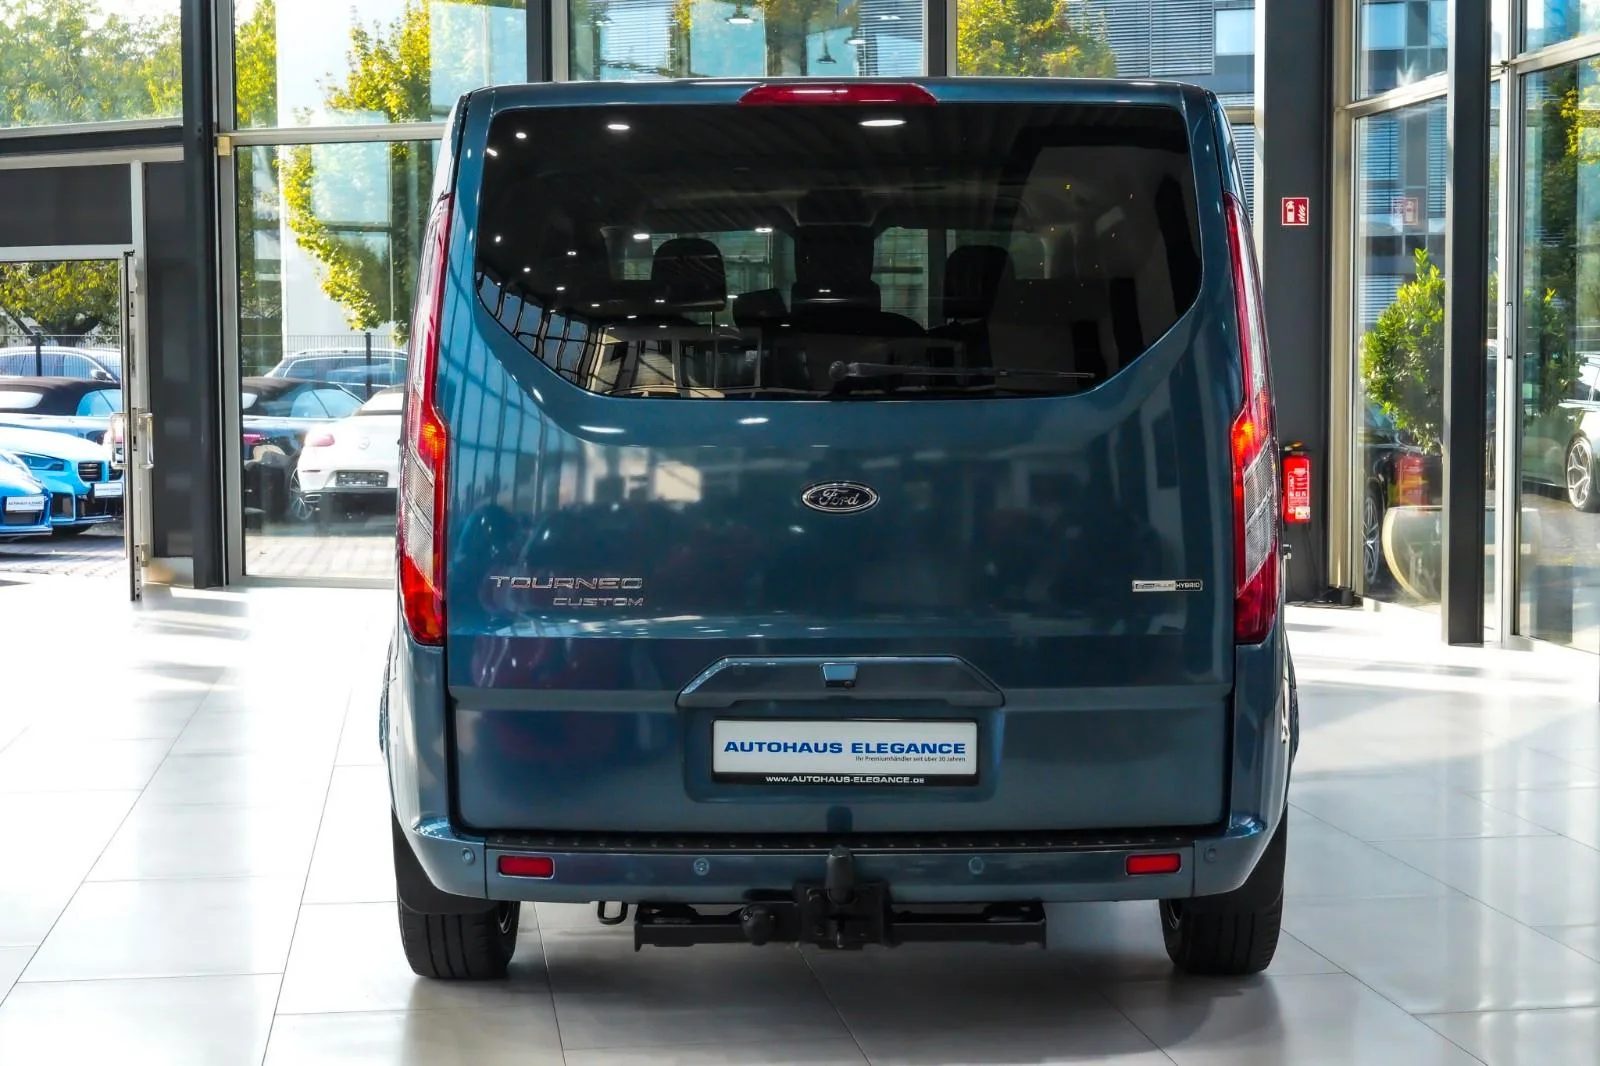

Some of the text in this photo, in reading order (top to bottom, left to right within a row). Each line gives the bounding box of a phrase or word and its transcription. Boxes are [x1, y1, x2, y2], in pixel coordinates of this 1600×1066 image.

[818, 488, 860, 506] Ford
[489, 576, 643, 589] TOURNEO
[552, 597, 644, 606] CUSTOM
[724, 741, 966, 754] AUTOHAUS ELEGANCE
